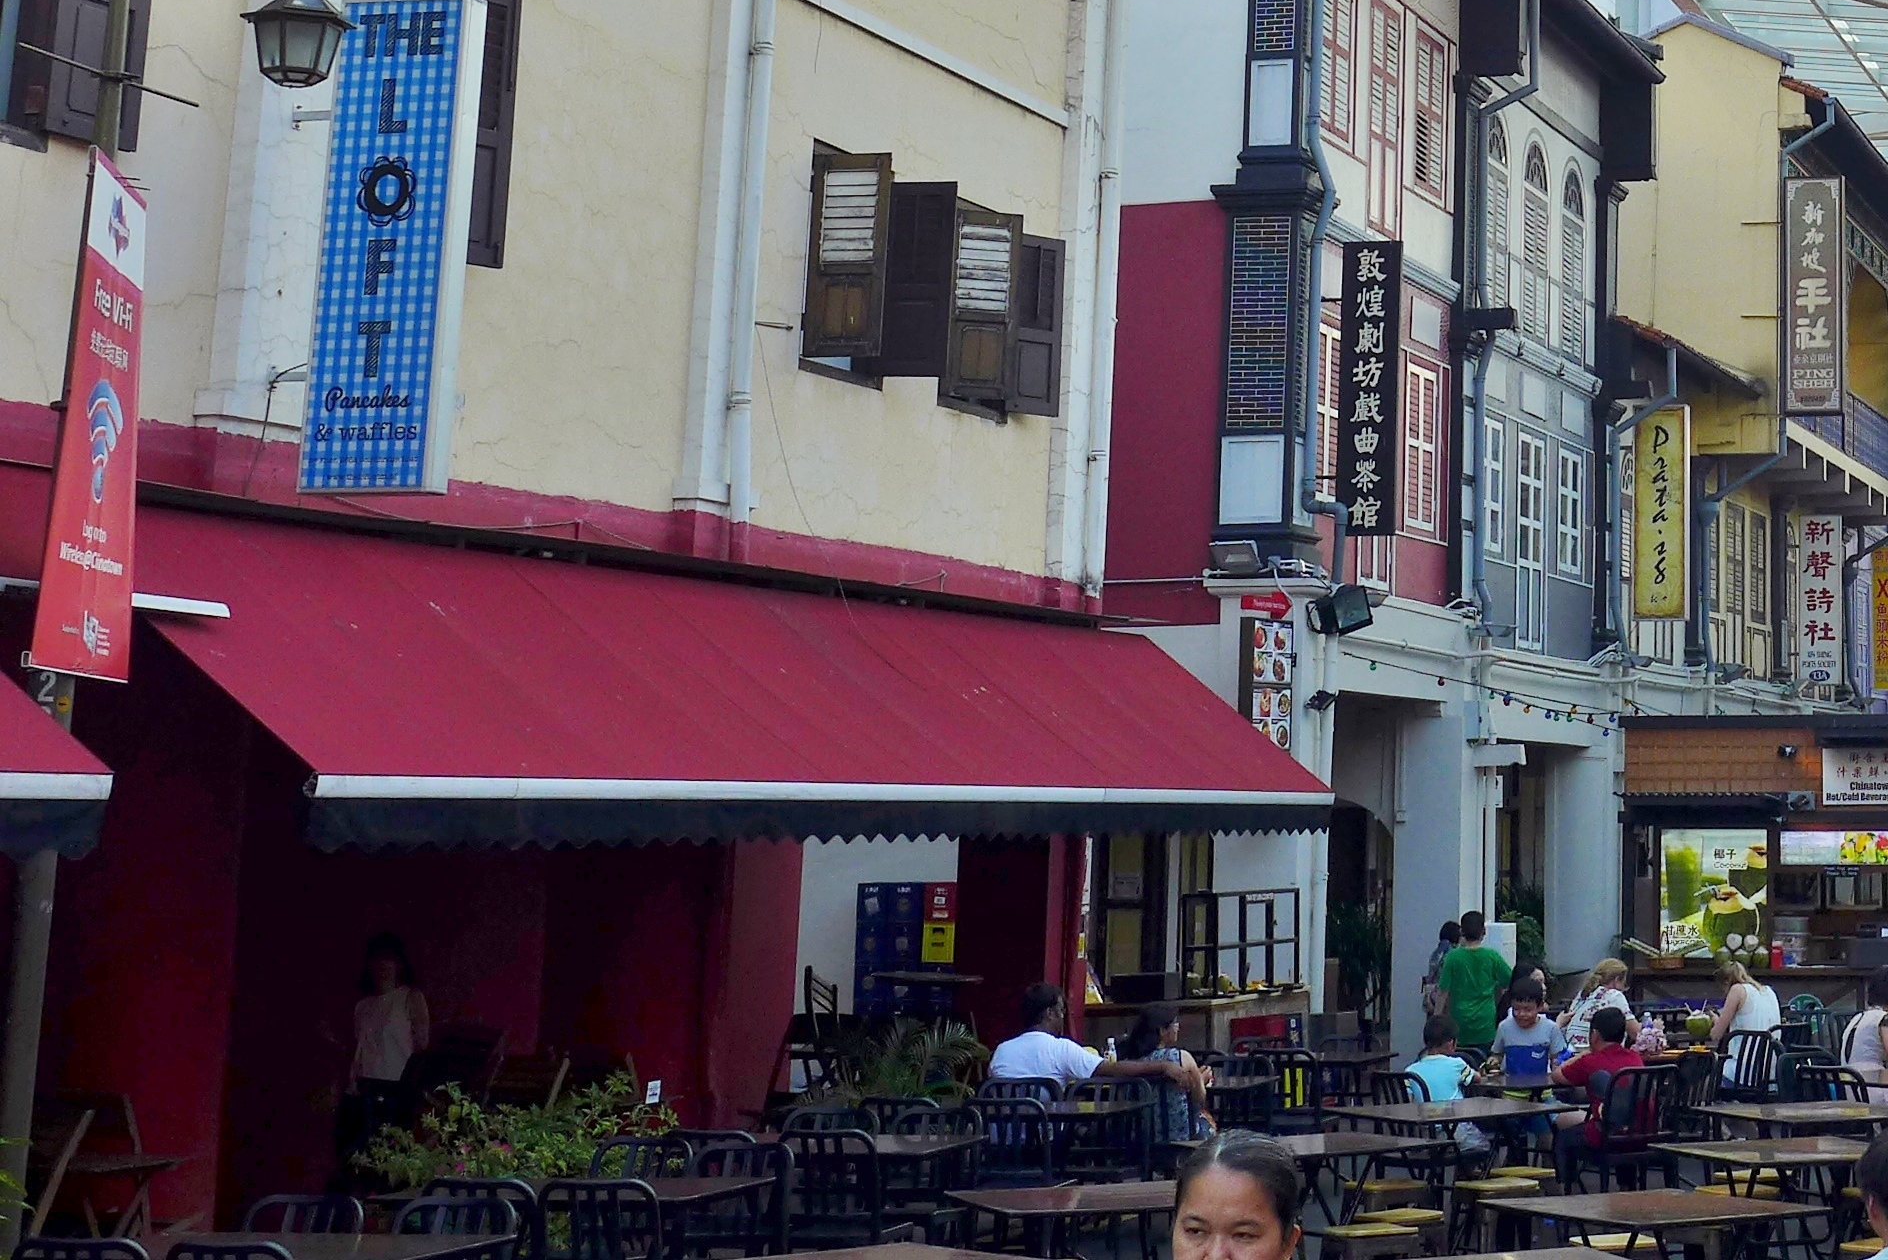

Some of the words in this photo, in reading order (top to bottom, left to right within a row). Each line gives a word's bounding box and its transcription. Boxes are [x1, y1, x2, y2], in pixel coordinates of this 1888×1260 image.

[360, 11, 447, 57] THE
[1792, 369, 1834, 379] PING
[325, 384, 412, 412] Pancakes
[314, 423, 334, 441] &
[338, 421, 417, 441] waffles
[1713, 848, 1737, 860] 椰子
